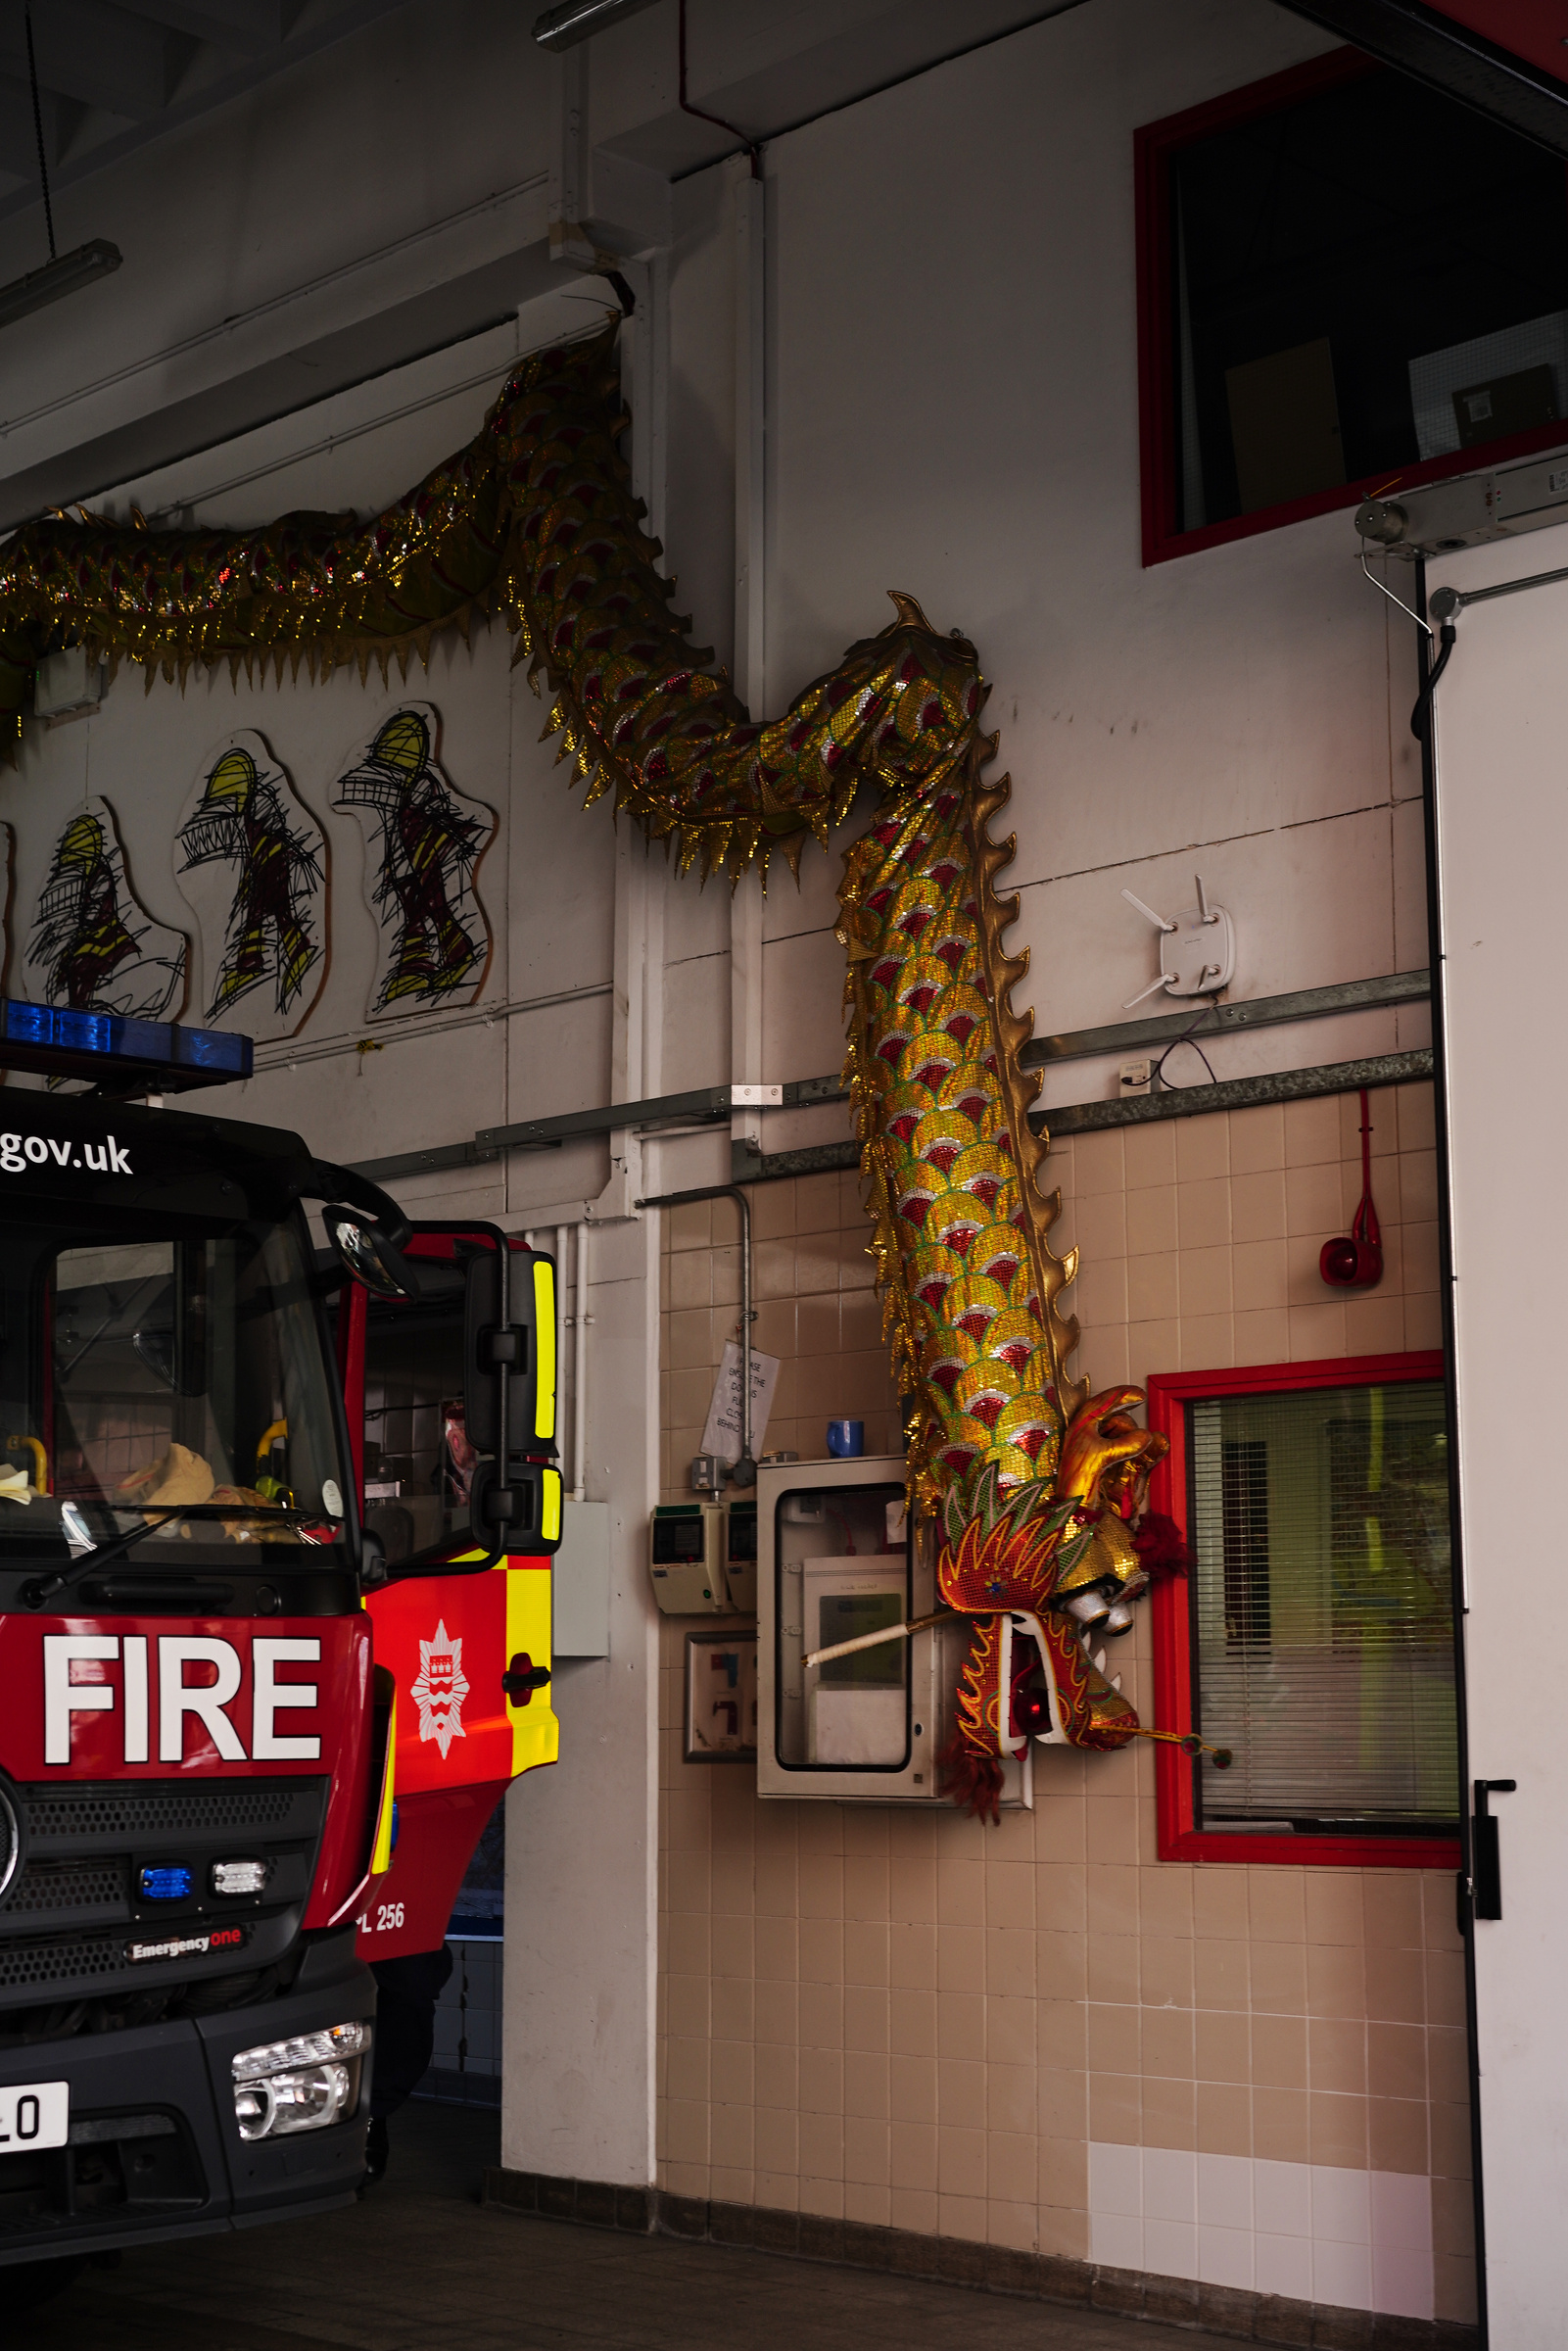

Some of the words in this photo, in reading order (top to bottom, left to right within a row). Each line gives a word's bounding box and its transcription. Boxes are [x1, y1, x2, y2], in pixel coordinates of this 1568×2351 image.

[0, 1132, 134, 1175] gov.uk
[753, 1376, 766, 1388] THE
[717, 1417, 740, 1432] BEHIND
[43, 1634, 321, 1764] FIRE
[376, 1902, 404, 1931] 256
